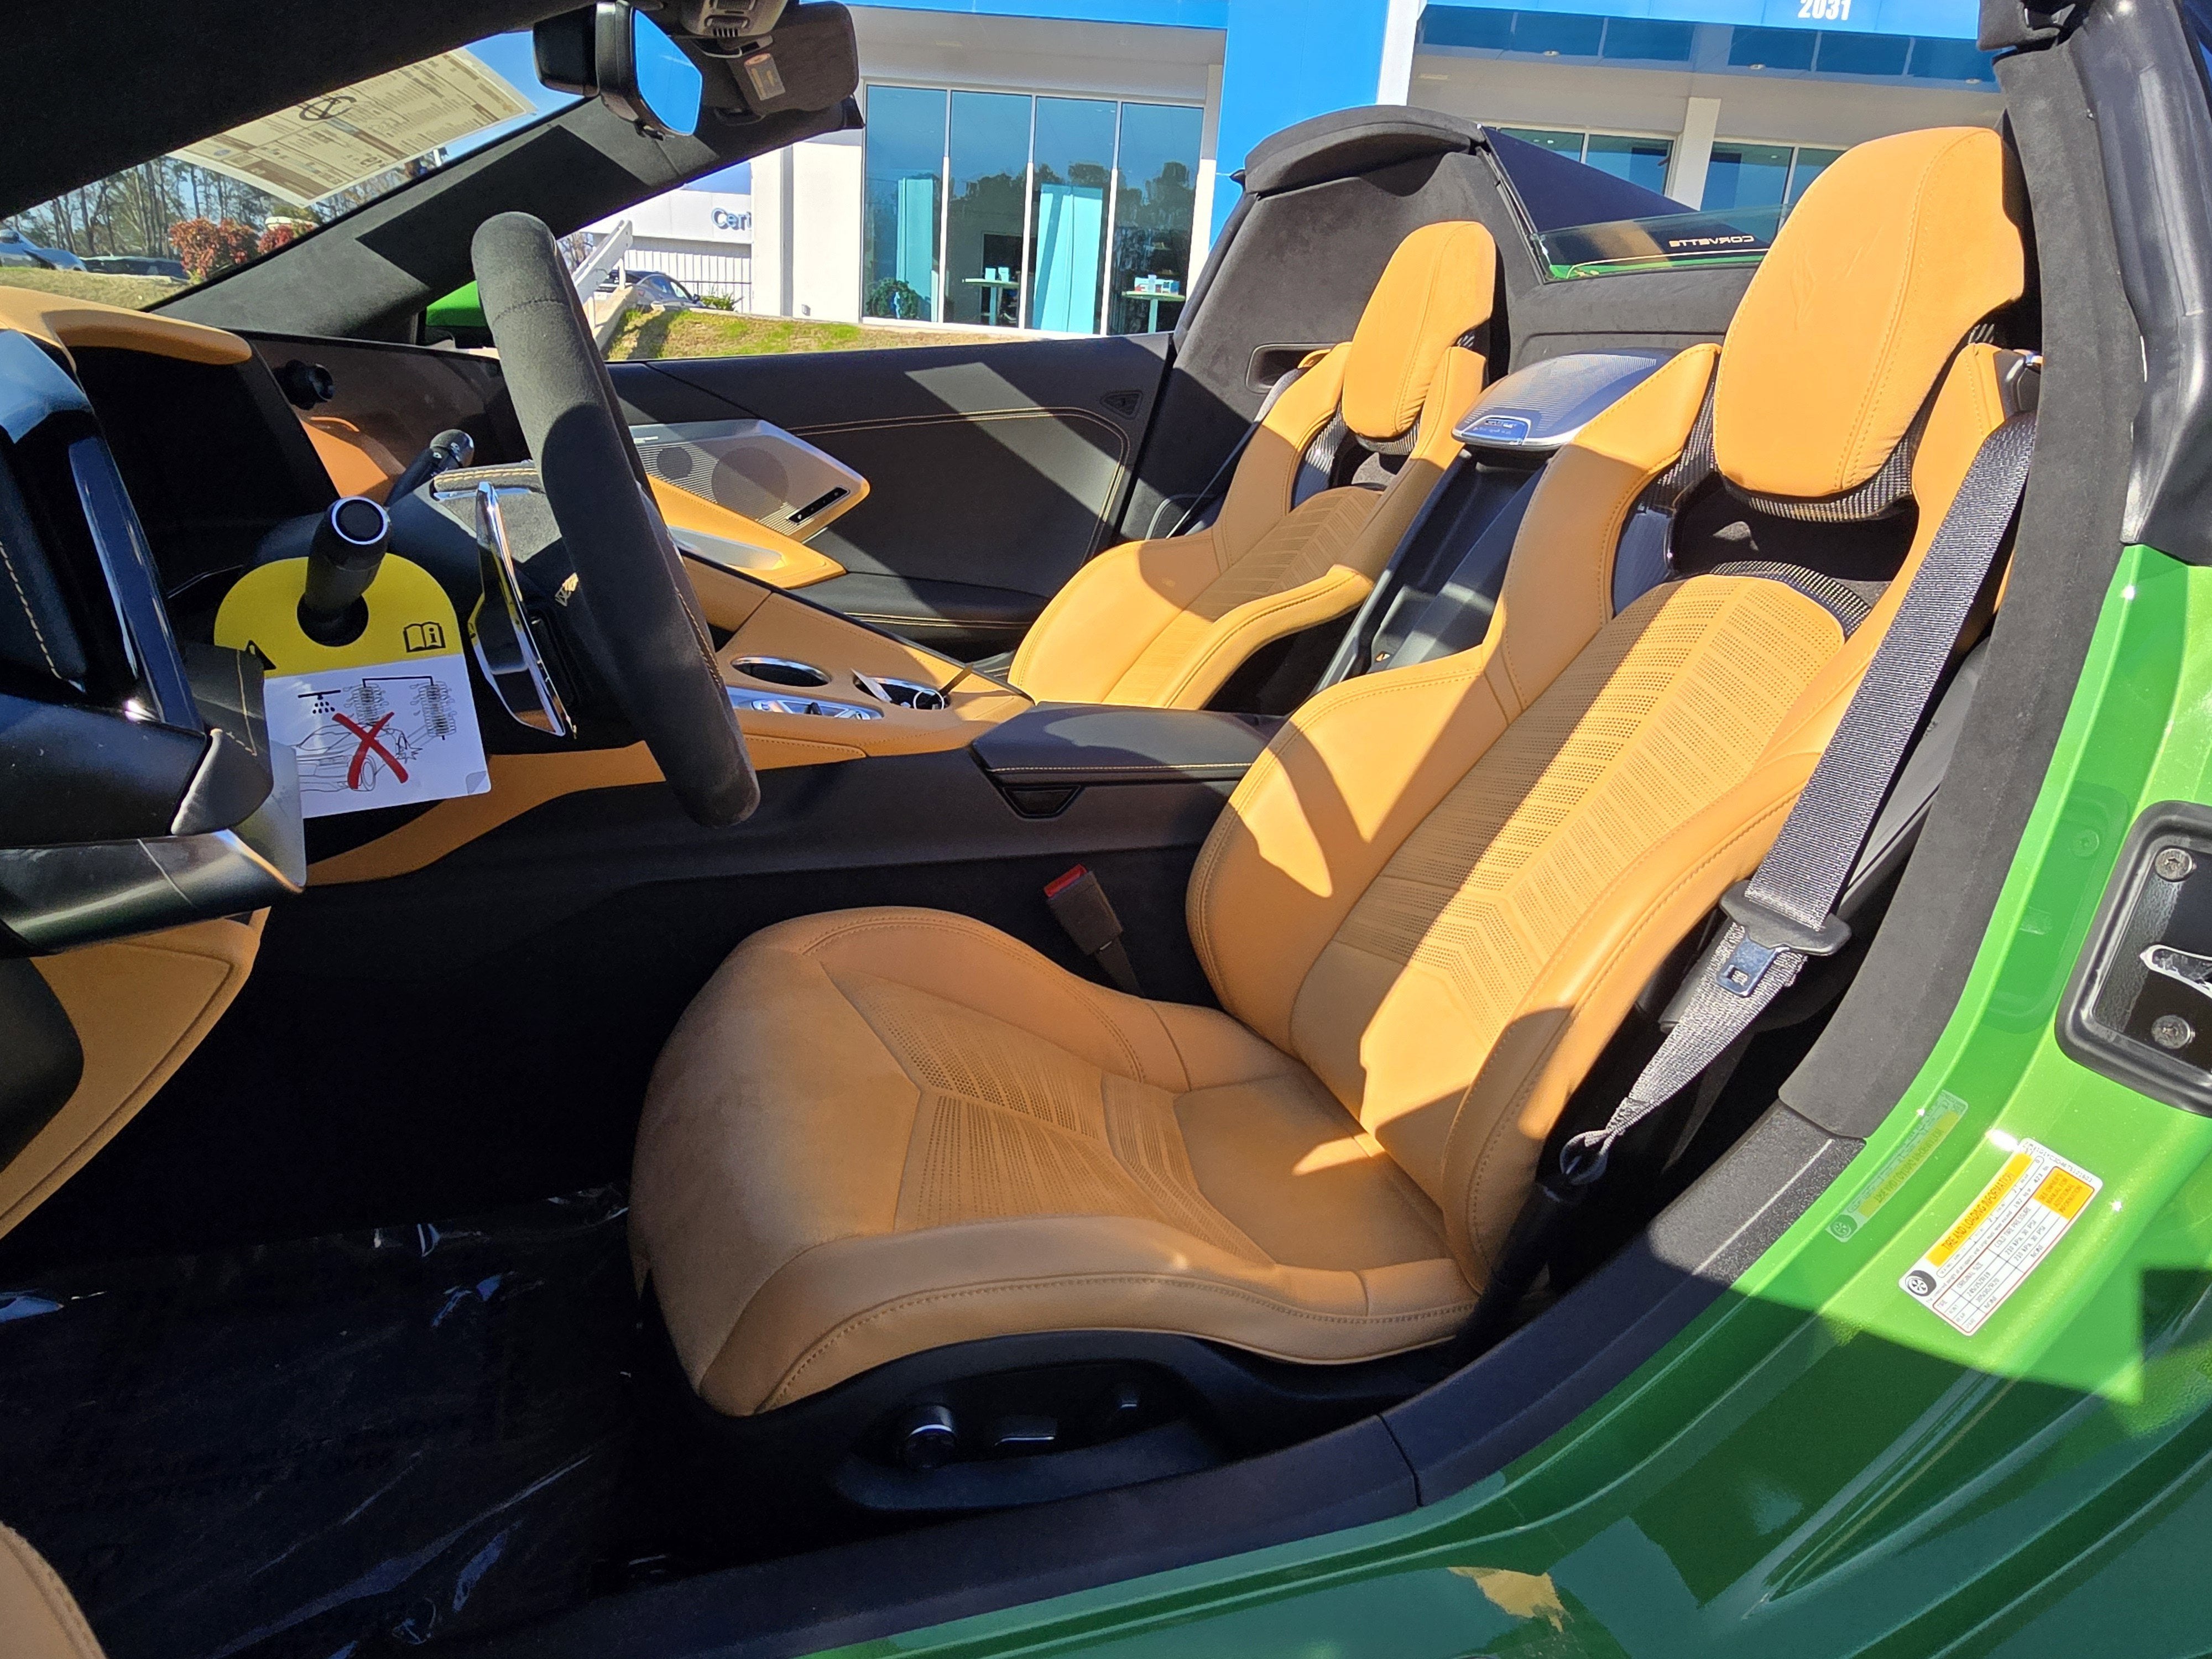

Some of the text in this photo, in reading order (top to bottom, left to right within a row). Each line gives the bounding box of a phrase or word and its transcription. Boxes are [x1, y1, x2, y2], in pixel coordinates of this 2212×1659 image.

[1798, 0, 1851, 20] 2031
[1940, 1235, 1958, 1251] TIRE
[1951, 1225, 1967, 1240] AND
[1960, 1203, 1987, 1229] LOADING
[1979, 1170, 2016, 1207] INFORMATION
